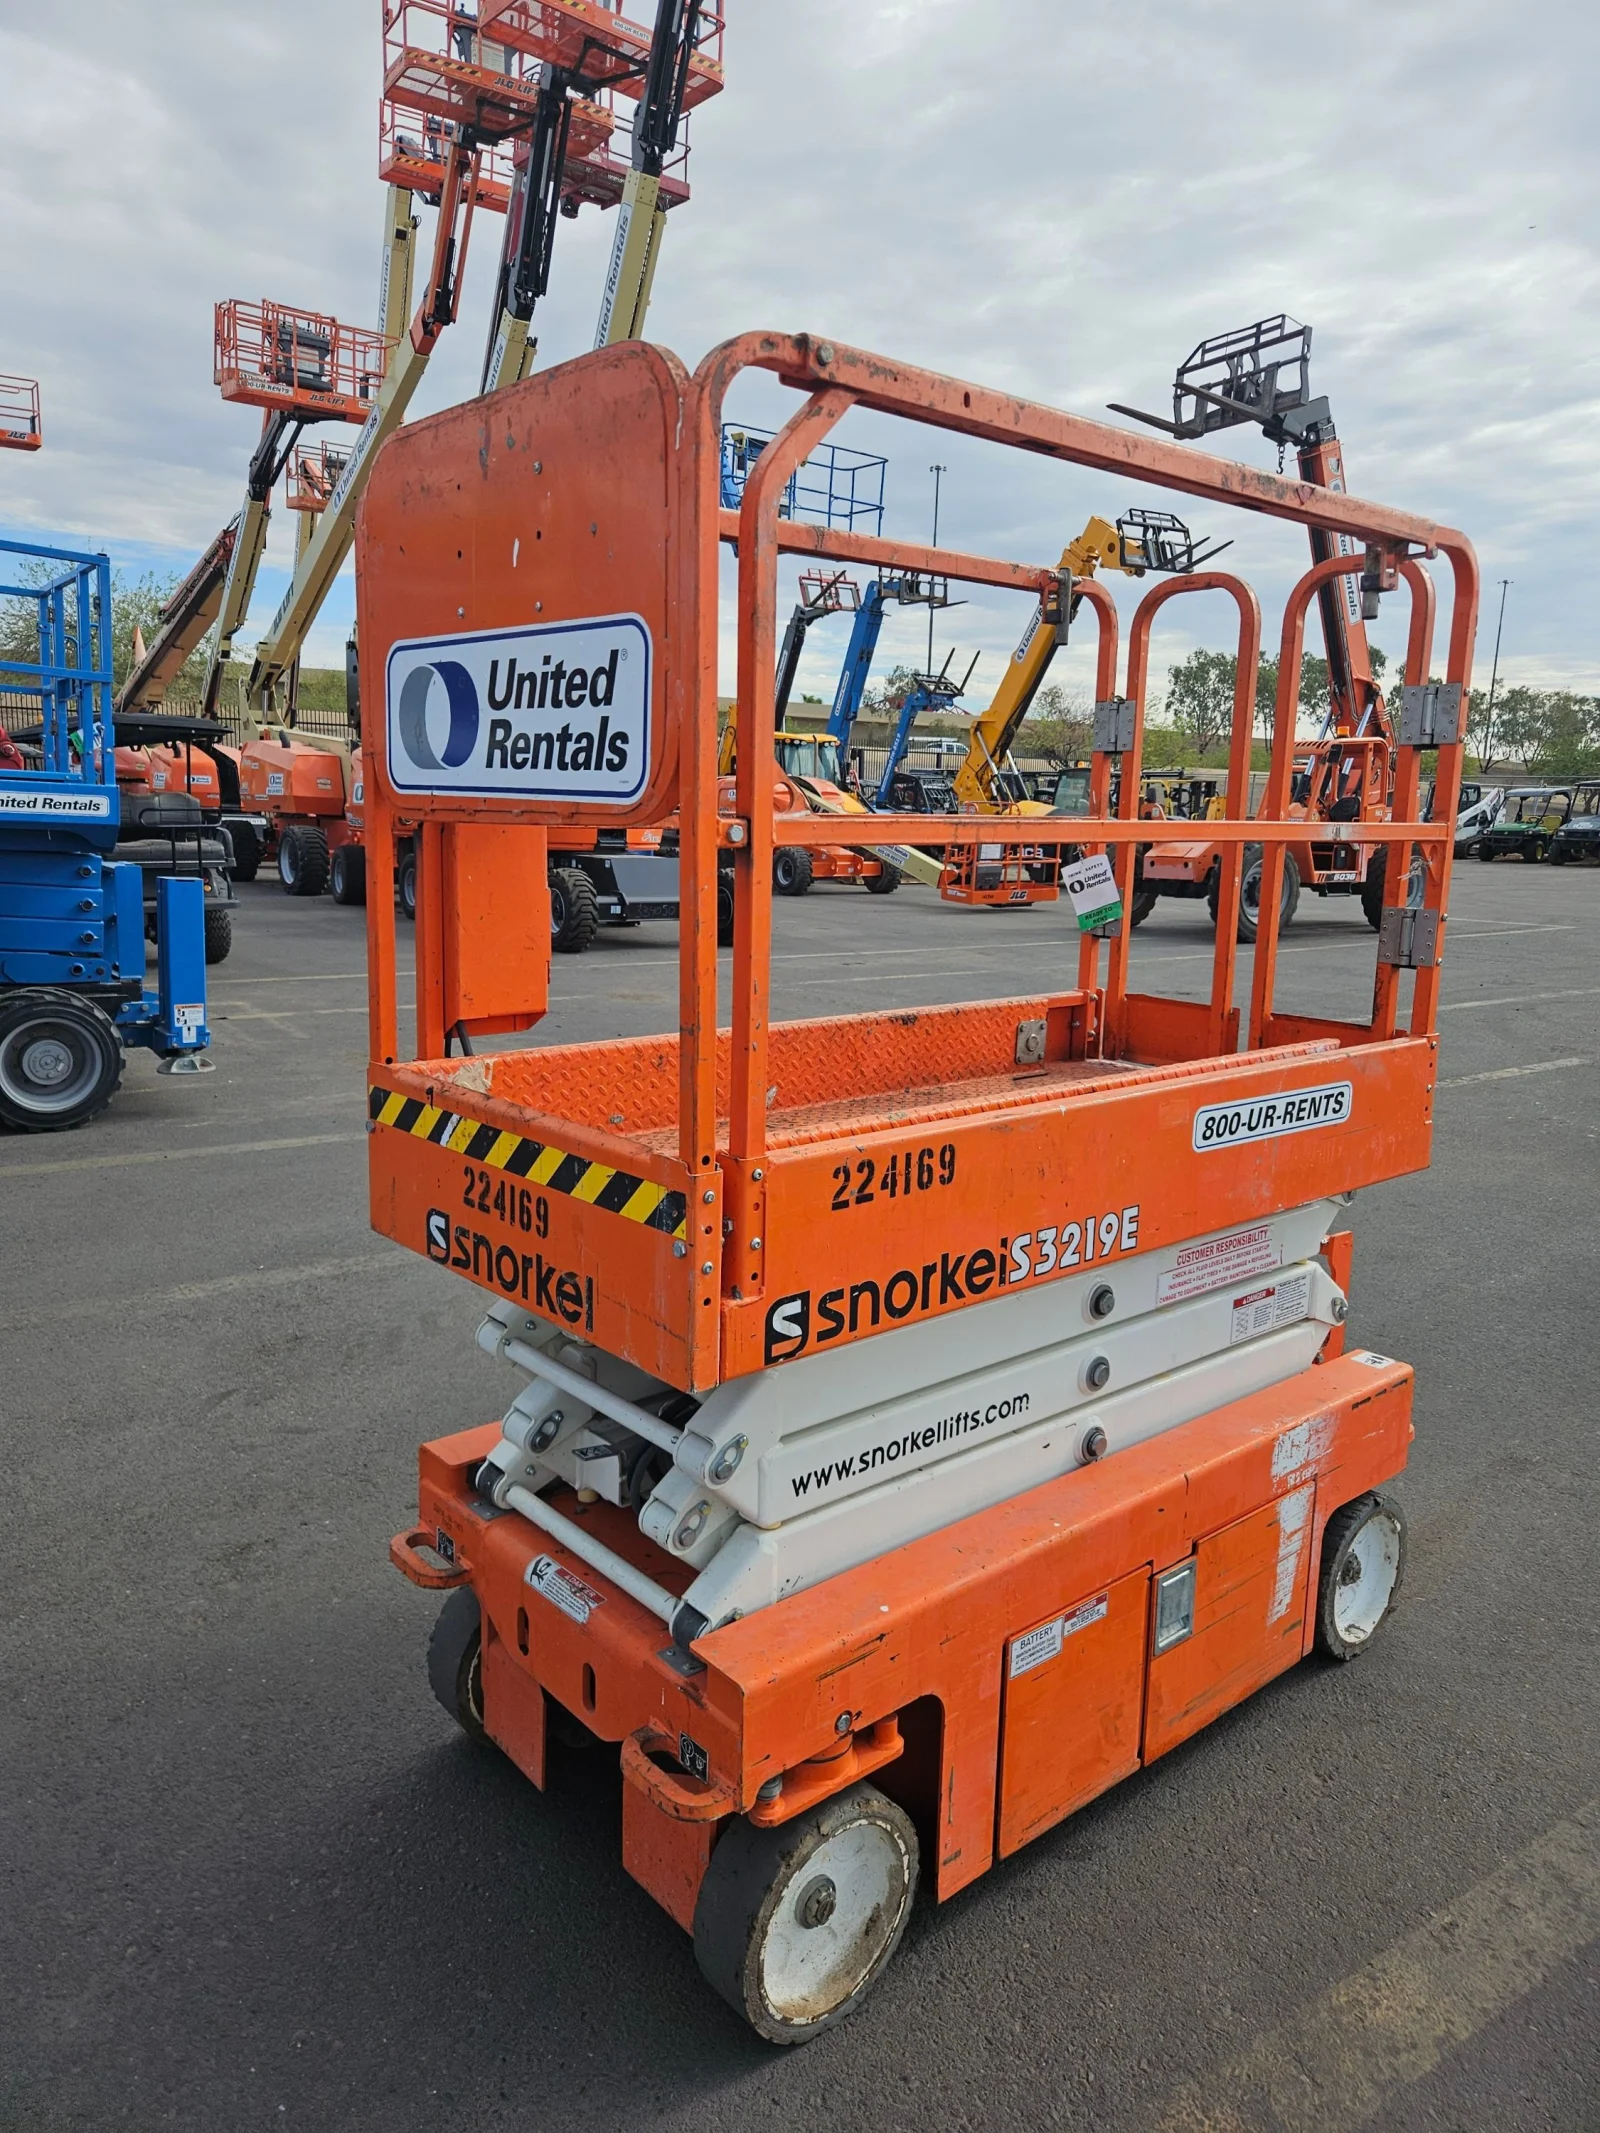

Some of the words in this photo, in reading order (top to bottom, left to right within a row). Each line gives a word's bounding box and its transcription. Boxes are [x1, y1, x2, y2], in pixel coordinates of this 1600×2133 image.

[614, 20, 650, 41] 800-UR-RENTS
[494, 77, 515, 89] JLG
[598, 297, 613, 349] nited
[607, 214, 629, 294] Rentals
[486, 343, 505, 394] entals
[309, 393, 325, 402] JLG
[7, 431, 27, 440] JLG
[340, 453, 359, 493] United
[357, 414, 378, 457] Rentals
[273, 606, 283, 636] JLG
[282, 581, 294, 614] LIFT
[1345, 574, 1358, 617] entals
[1023, 615, 1040, 648] United
[487, 649, 619, 711] United
[485, 716, 629, 772] Rentals
[42, 797, 101, 812] Rentals
[1084, 869, 1109, 883] United
[1085, 862, 1103, 872] SAFETY
[1086, 876, 1112, 890] Rentals
[1333, 873, 1356, 881] 6036
[1009, 890, 1028, 900] JLG
[1084, 909, 1104, 921] READY
[1104, 906, 1113, 914] TO
[1092, 915, 1108, 925] RENT
[1202, 1091, 1345, 1141] 800-UR-RENTS
[832, 1143, 957, 1211] 224169
[463, 1166, 549, 1239] 224169
[1008, 1204, 1140, 1284] S3219E
[1172, 1270, 1187, 1280] CHECK
[1187, 1267, 1196, 1275] ALL
[1196, 1263, 1208, 1273] FLUID
[1208, 1259, 1224, 1269] LEVELS
[1224, 1255, 1236, 1264] DAILY
[1236, 1250, 1251, 1260] BEFORE
[1252, 1243, 1270, 1255] START-UP
[1176, 1247, 1214, 1266] CUSTOMER
[1215, 1228, 1269, 1254] RESPONSIBILITY
[451, 1224, 594, 1332] snorkel
[1159, 1293, 1177, 1304] DAMAGE
[1184, 1282, 1208, 1296] EQUIPMENT
[1211, 1275, 1229, 1286] BATTERY
[1229, 1266, 1256, 1279] MAINTENANCE
[1168, 1279, 1193, 1291] INSURANCE
[1195, 1274, 1206, 1282] FLAT
[1206, 1270, 1219, 1279] TIRES
[1222, 1265, 1231, 1273] TIRE
[1231, 1260, 1248, 1271] DAMAGE
[1251, 1251, 1272, 1263] REFUELING
[1246, 1291, 1267, 1304] DANGER
[791, 1392, 1030, 1498] www.snorkellifts.com
[1020, 1624, 1055, 1650] BATTERY
